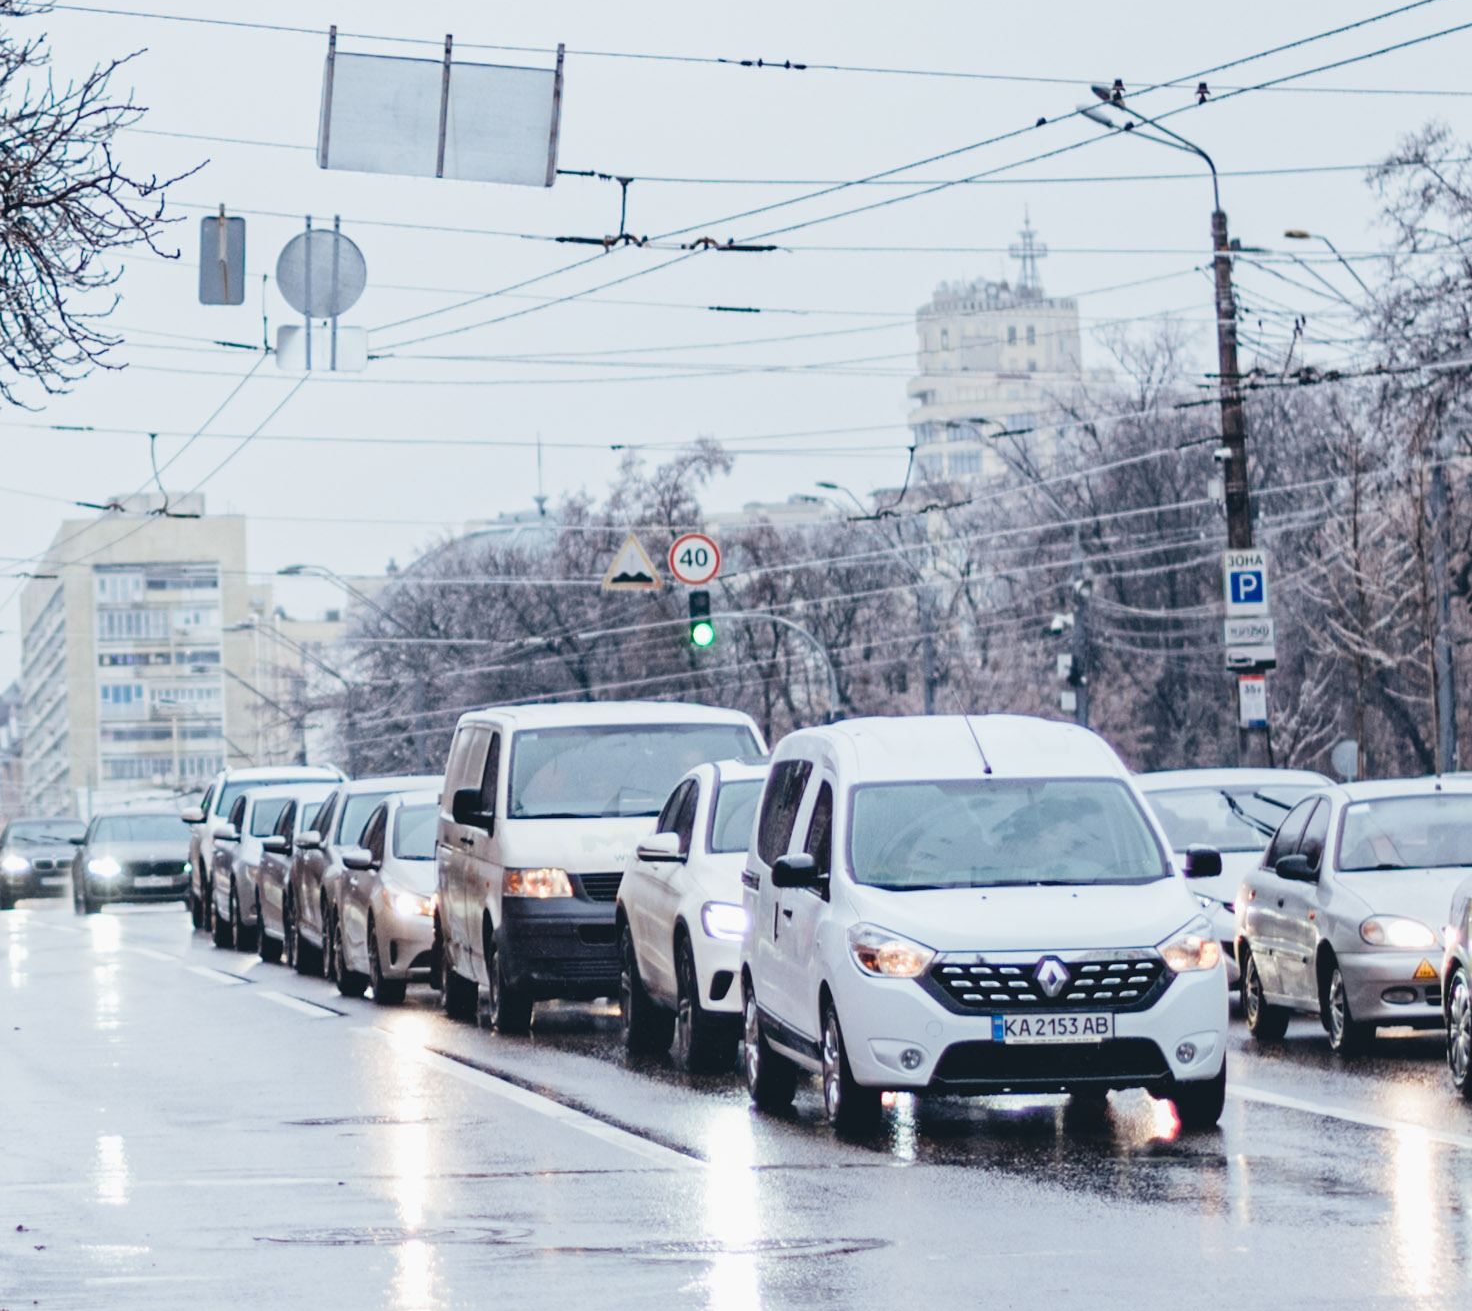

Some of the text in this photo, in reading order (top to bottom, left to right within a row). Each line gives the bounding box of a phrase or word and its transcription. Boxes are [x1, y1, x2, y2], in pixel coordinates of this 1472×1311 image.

[679, 548, 708, 567] 40
[1228, 554, 1263, 567] ЗОНА
[1239, 574, 1257, 601] P
[1004, 1016, 1109, 1036] KA 2153 AB
